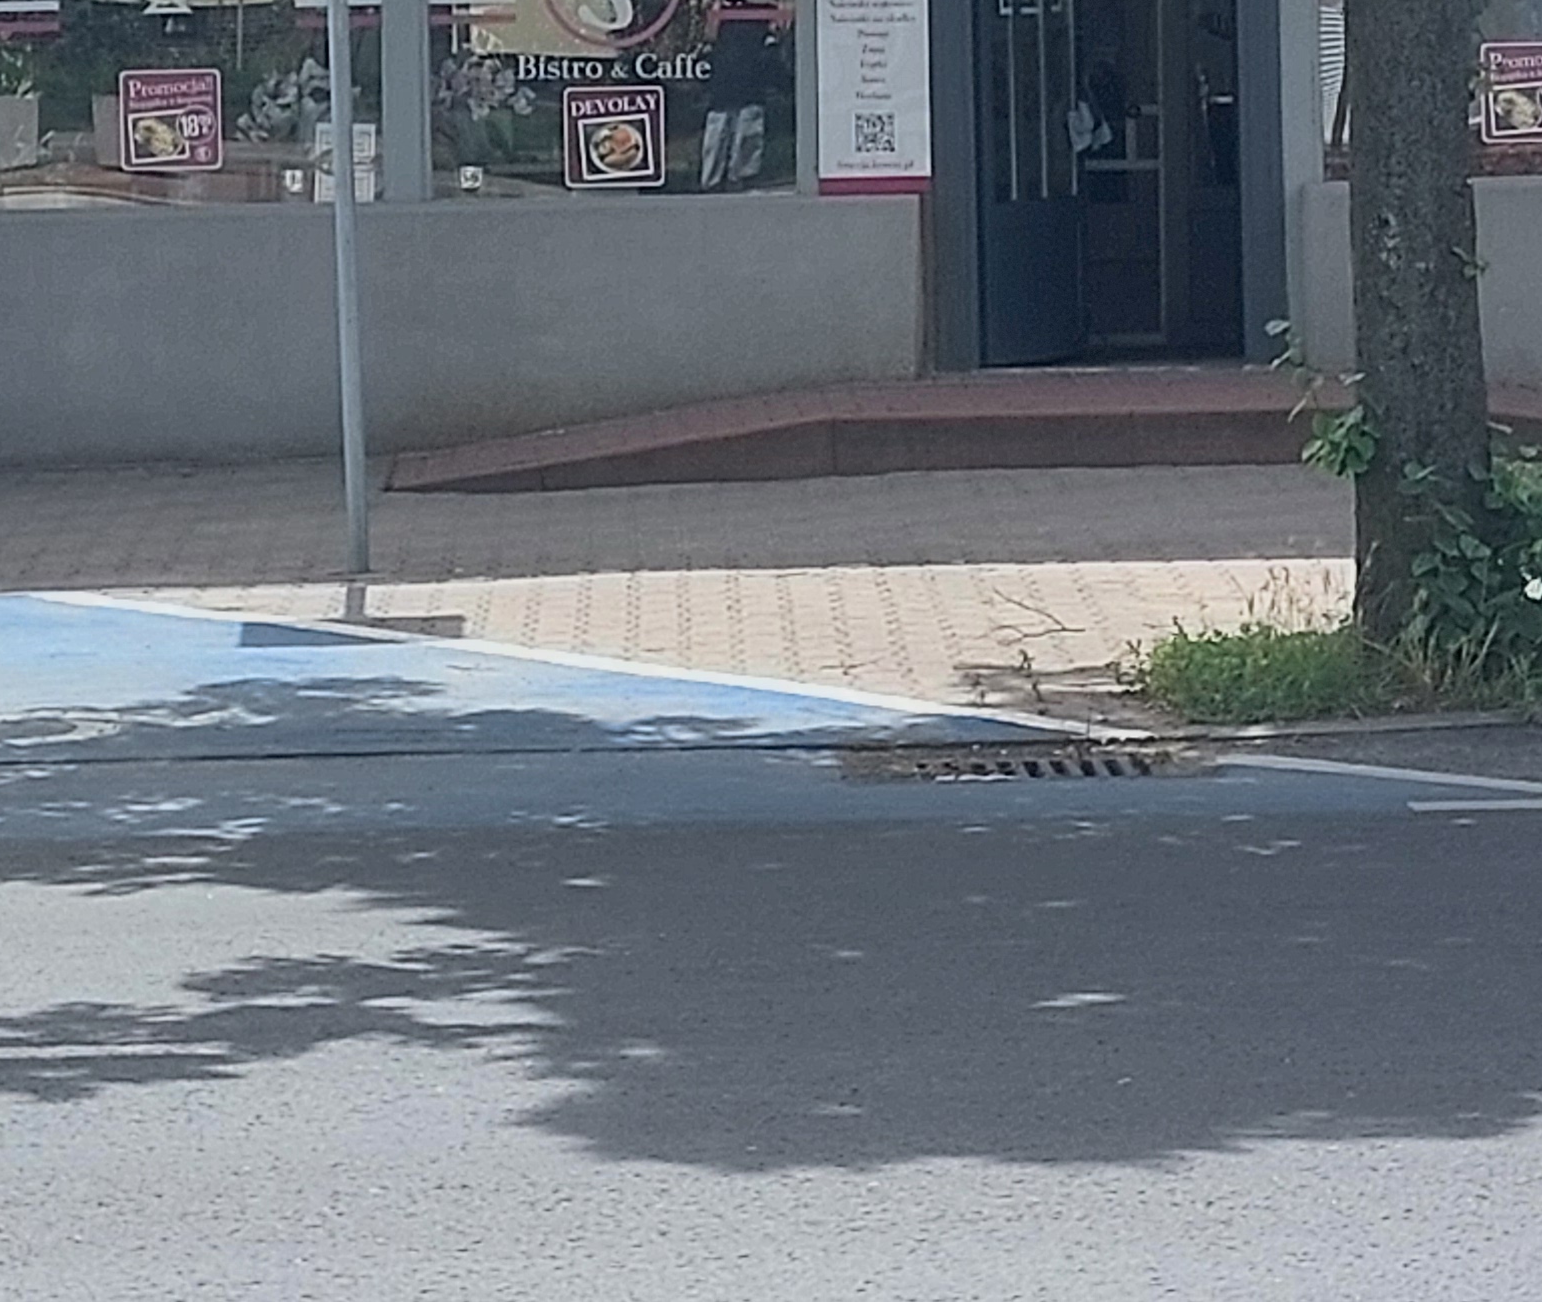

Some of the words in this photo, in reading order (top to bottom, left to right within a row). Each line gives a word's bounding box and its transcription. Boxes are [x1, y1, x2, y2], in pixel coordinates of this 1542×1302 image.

[517, 54, 603, 80] Bistro
[610, 63, 629, 79] &
[635, 52, 712, 79] Caffe
[570, 94, 658, 118] DEVOLAY
